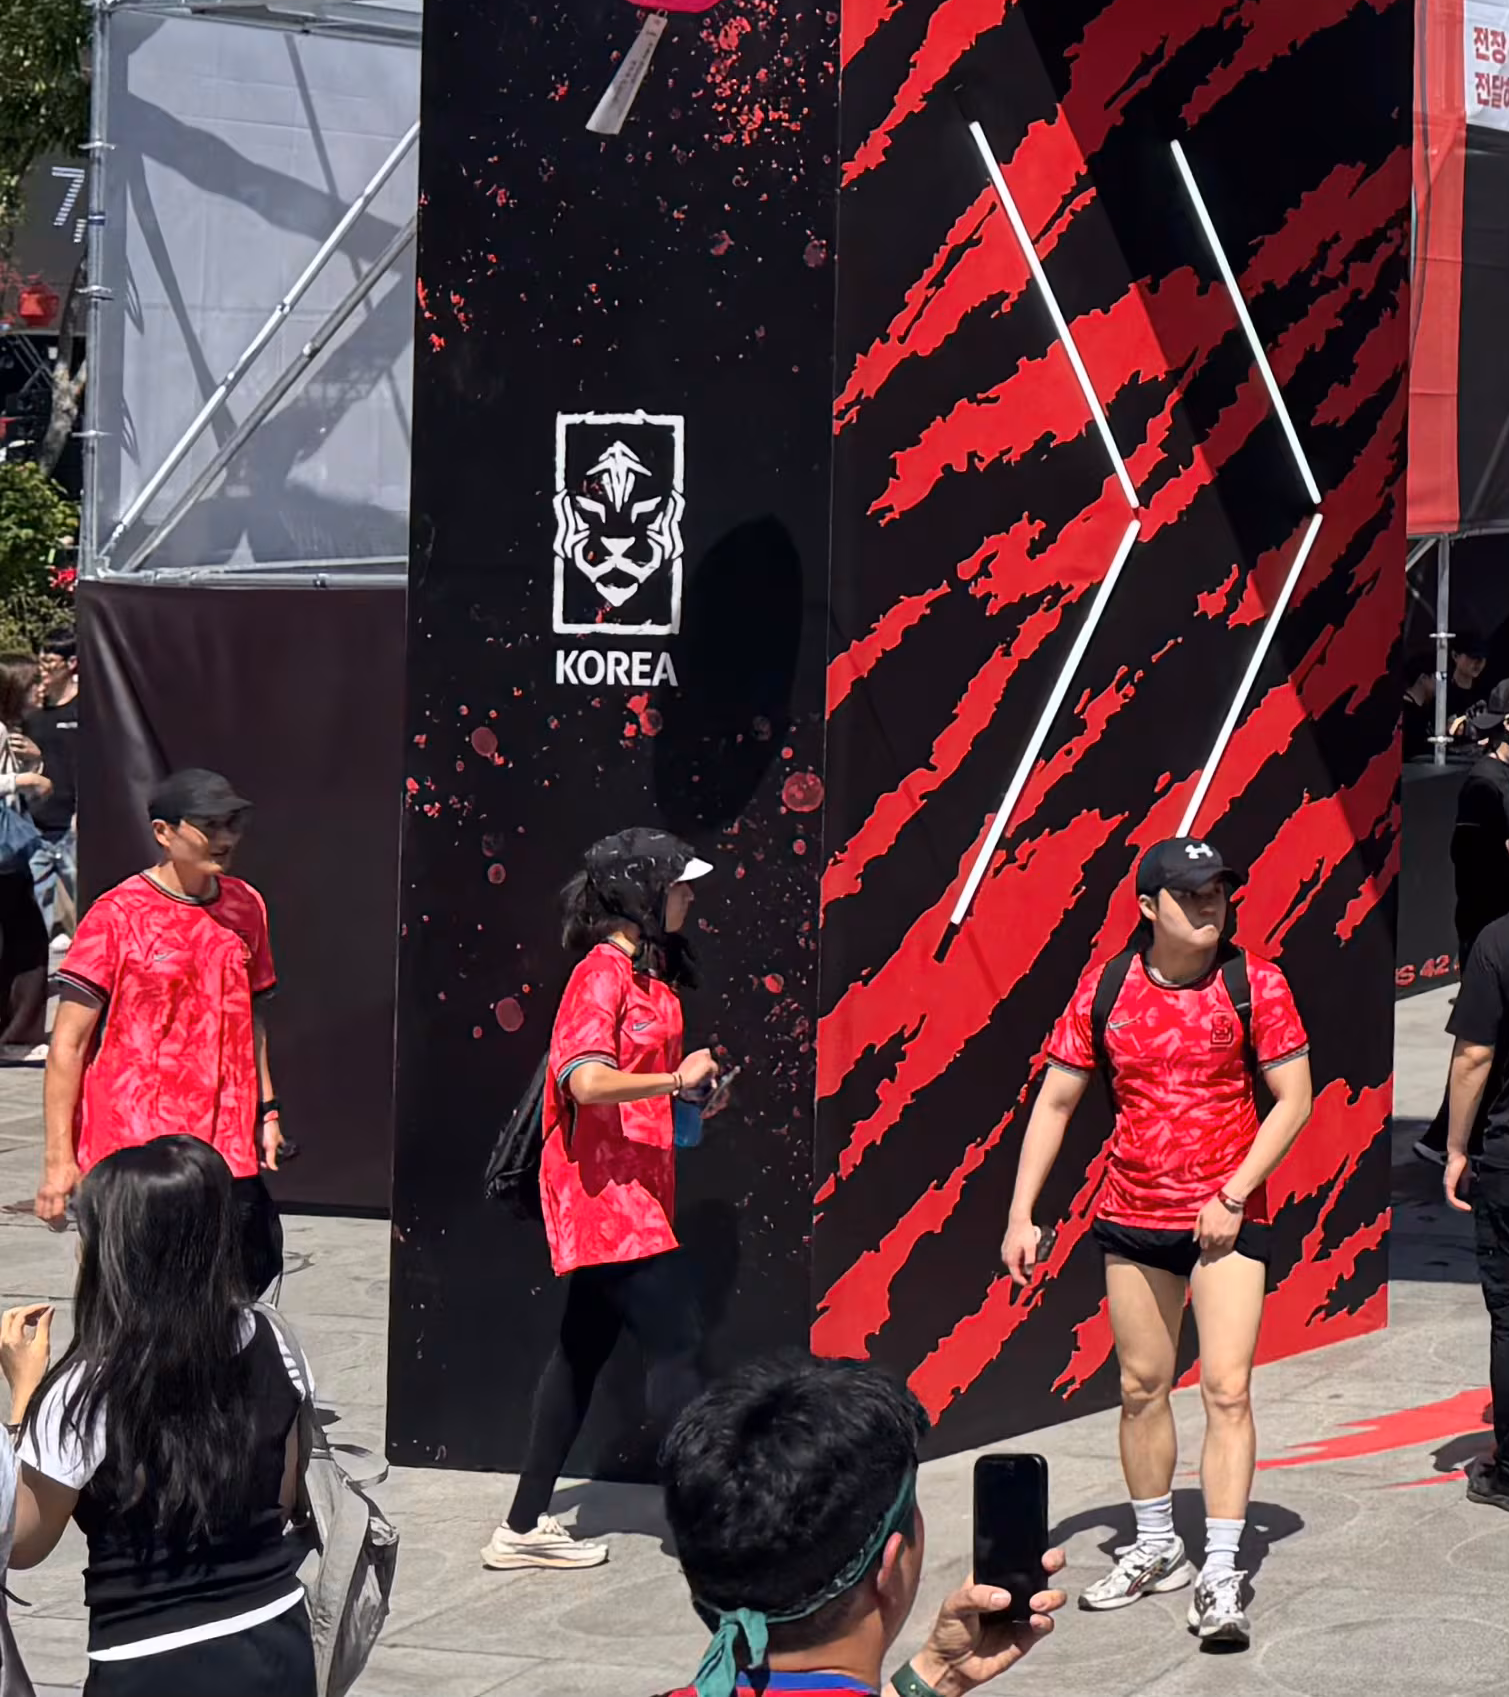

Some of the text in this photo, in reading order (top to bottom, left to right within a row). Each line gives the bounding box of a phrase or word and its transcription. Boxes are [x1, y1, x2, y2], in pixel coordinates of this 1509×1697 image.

[1473, 27, 1507, 64] 전장
[556, 649, 679, 687] KOREA
[1419, 954, 1450, 977] 42
